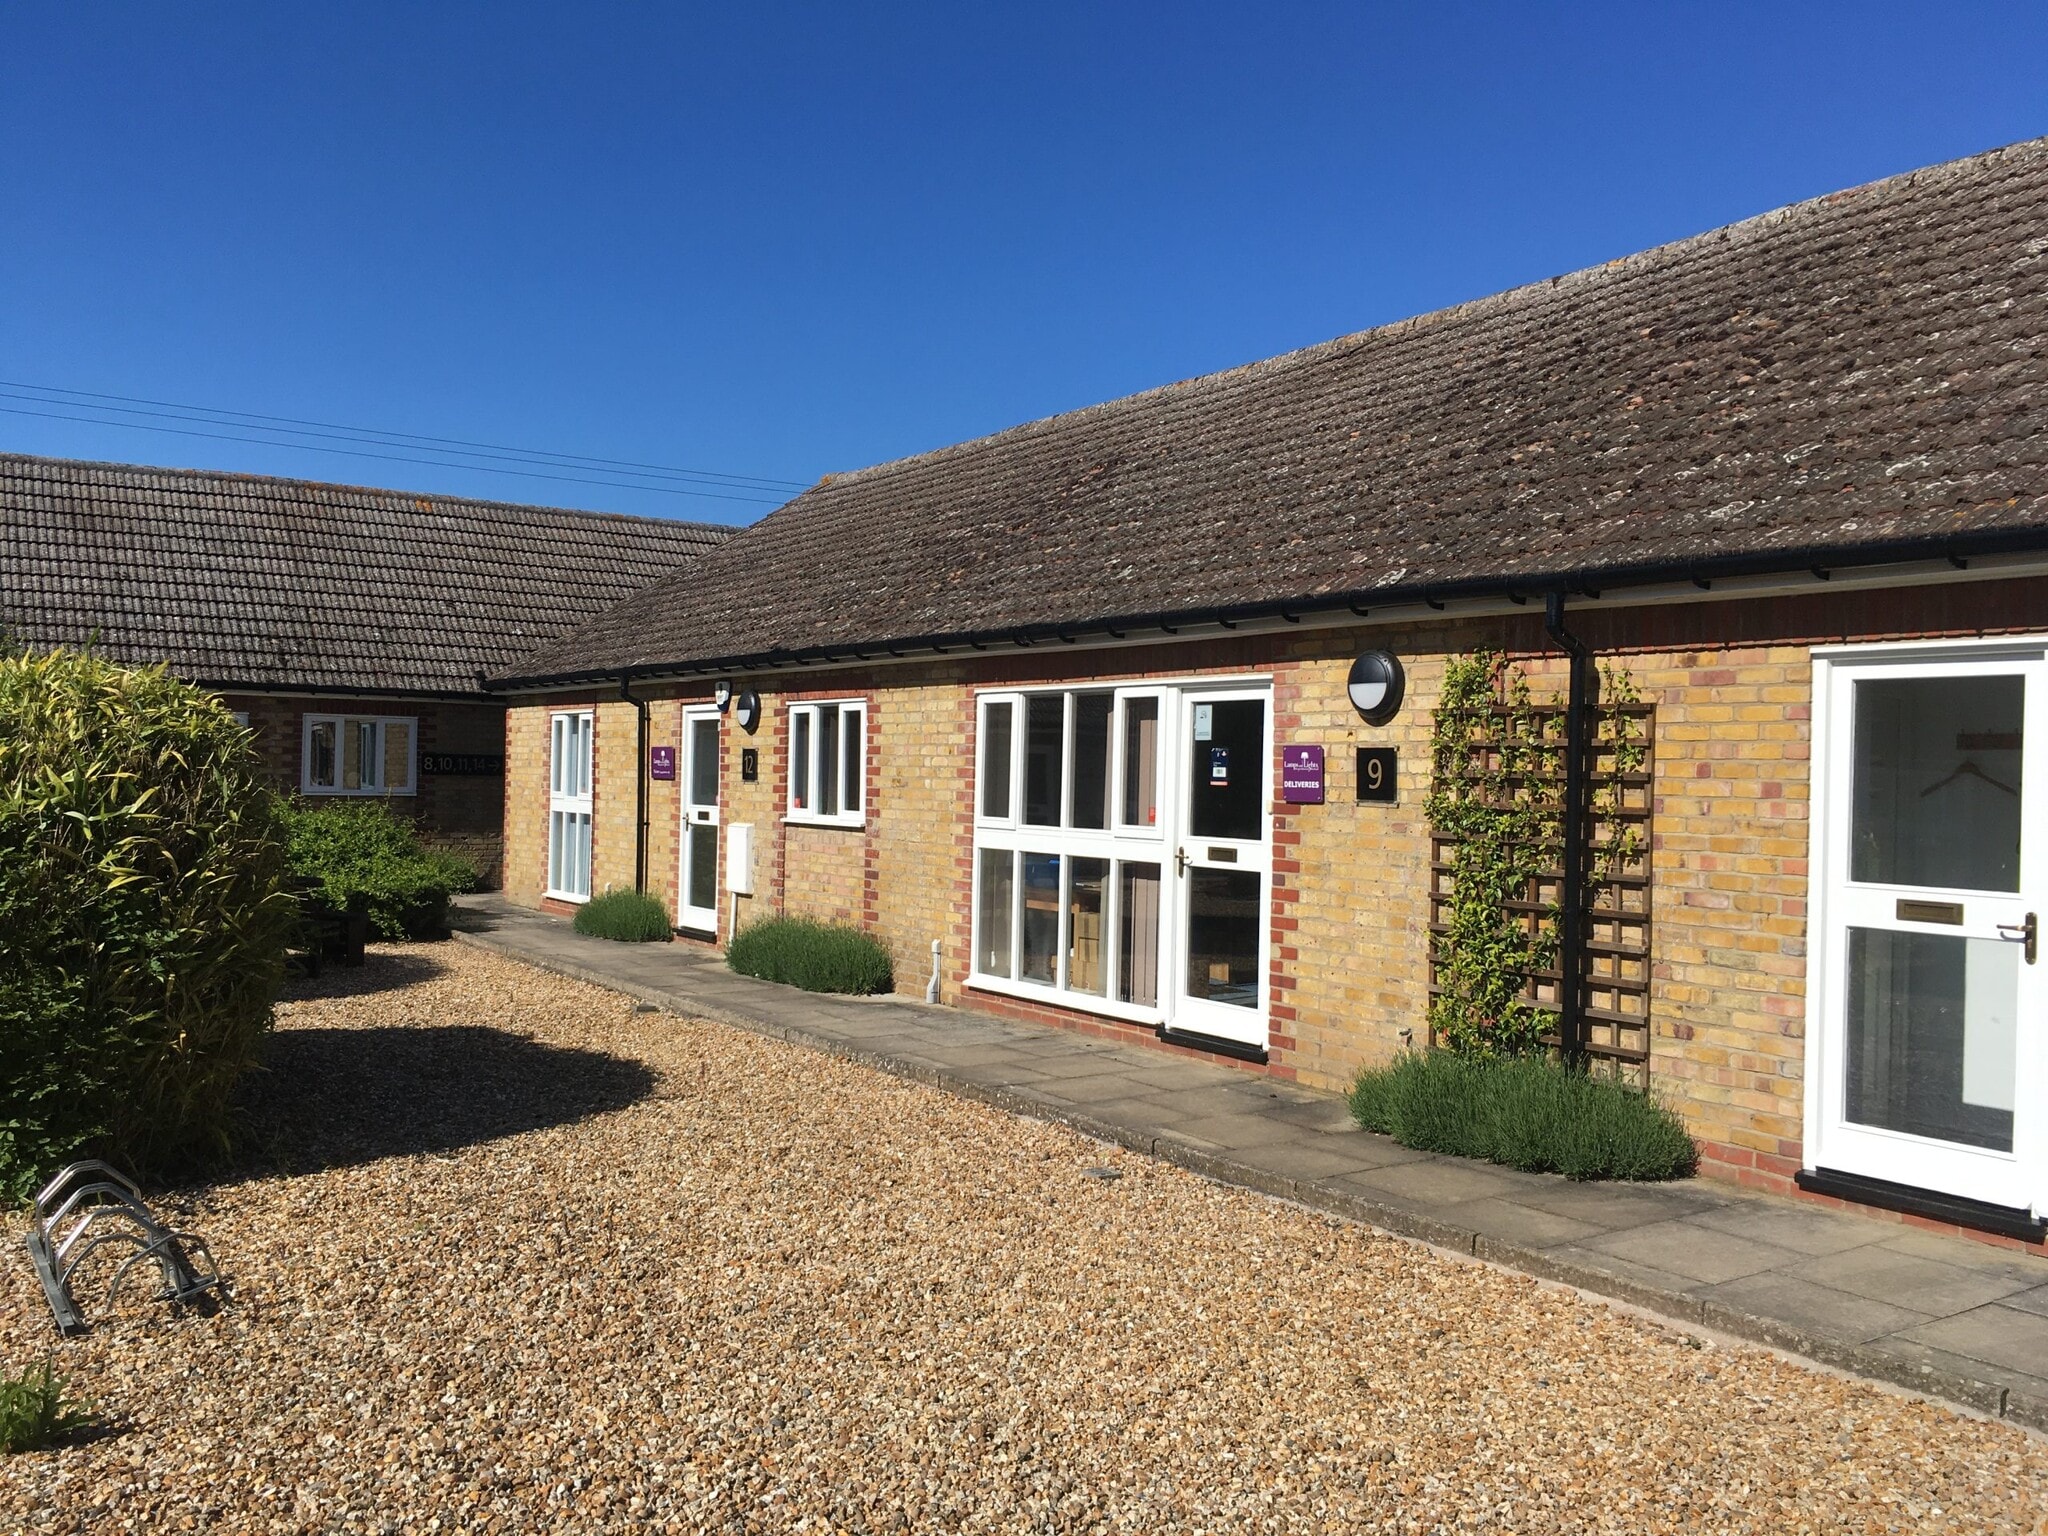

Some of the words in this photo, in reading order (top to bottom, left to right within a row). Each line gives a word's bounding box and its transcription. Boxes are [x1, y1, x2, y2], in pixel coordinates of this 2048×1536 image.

[744, 755, 754, 773] 12
[1367, 758, 1383, 790] 9
[1284, 780, 1320, 789] DELIVERIES
